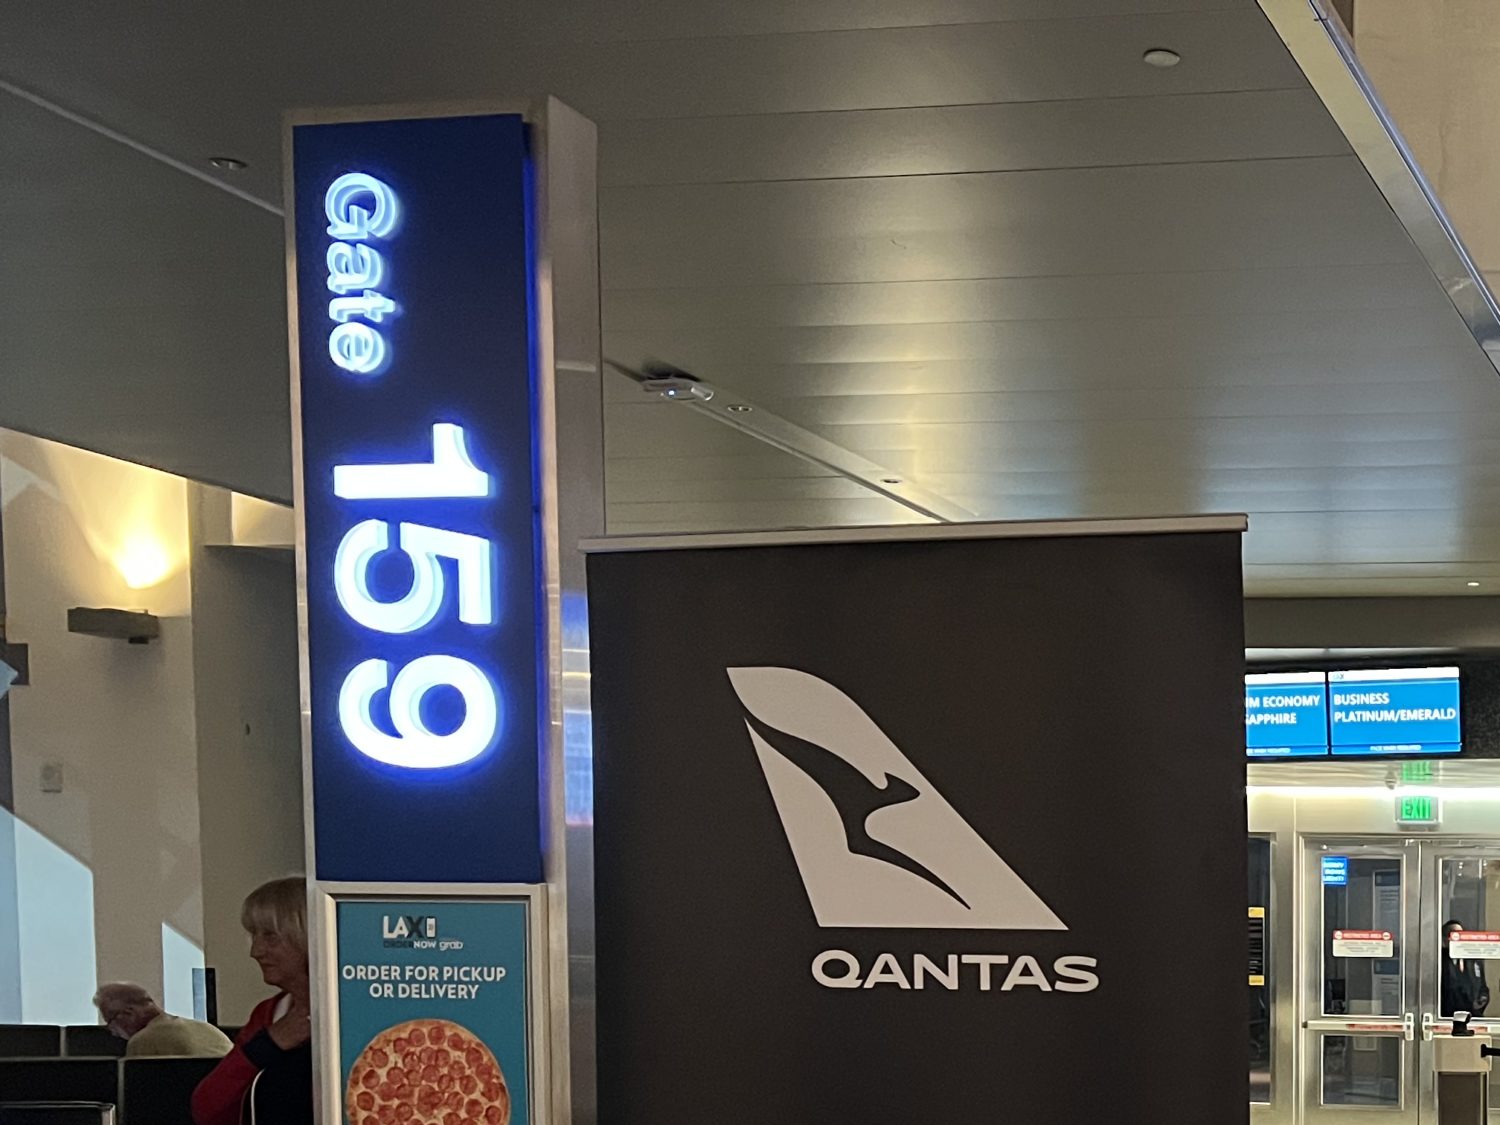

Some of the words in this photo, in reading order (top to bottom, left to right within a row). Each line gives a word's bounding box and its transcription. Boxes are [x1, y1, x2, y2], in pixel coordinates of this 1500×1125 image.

[324, 170, 400, 374] Gate
[331, 421, 499, 771] 159
[1263, 694, 1321, 707] ECONOMY
[1333, 692, 1390, 706] BUSINESS
[1333, 708, 1456, 723] PLATINUM/EMERALD
[1401, 797, 1430, 819] EXIT
[413, 940, 437, 949] NOW
[439, 940, 464, 952] grab
[342, 965, 400, 981] ORDER
[405, 966, 439, 981] FOR
[443, 966, 507, 982] PICKUP
[811, 949, 1100, 993] QANTAS
[369, 983, 394, 998] OR
[398, 984, 480, 999] DELIVERY
